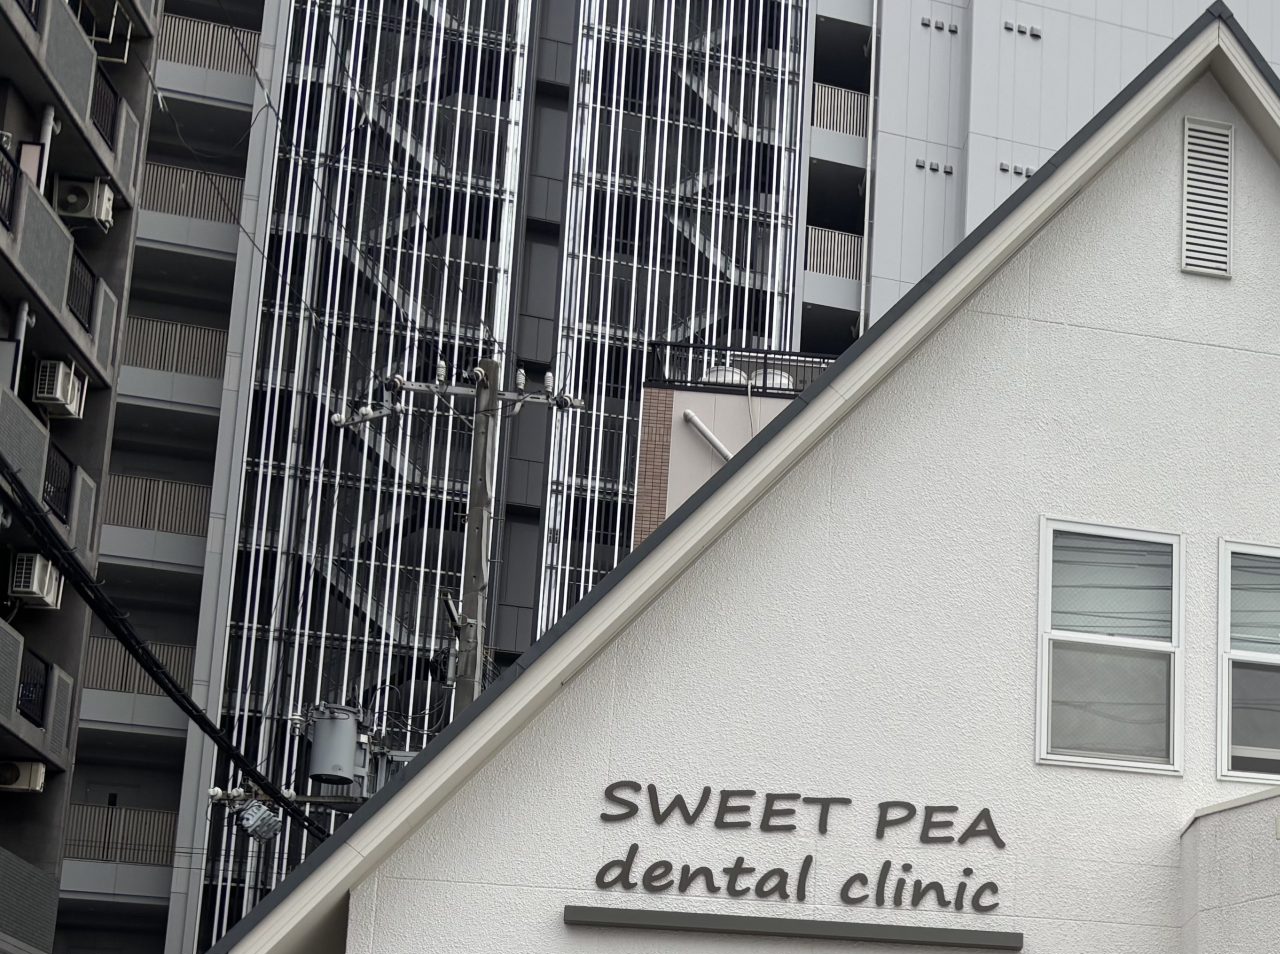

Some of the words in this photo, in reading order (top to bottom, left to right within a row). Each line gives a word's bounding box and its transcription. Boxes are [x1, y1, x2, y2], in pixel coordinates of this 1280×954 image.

[600, 781, 851, 834] SWEET
[876, 801, 1006, 849] PEA
[595, 843, 813, 902] dental
[840, 860, 999, 912] clinic
